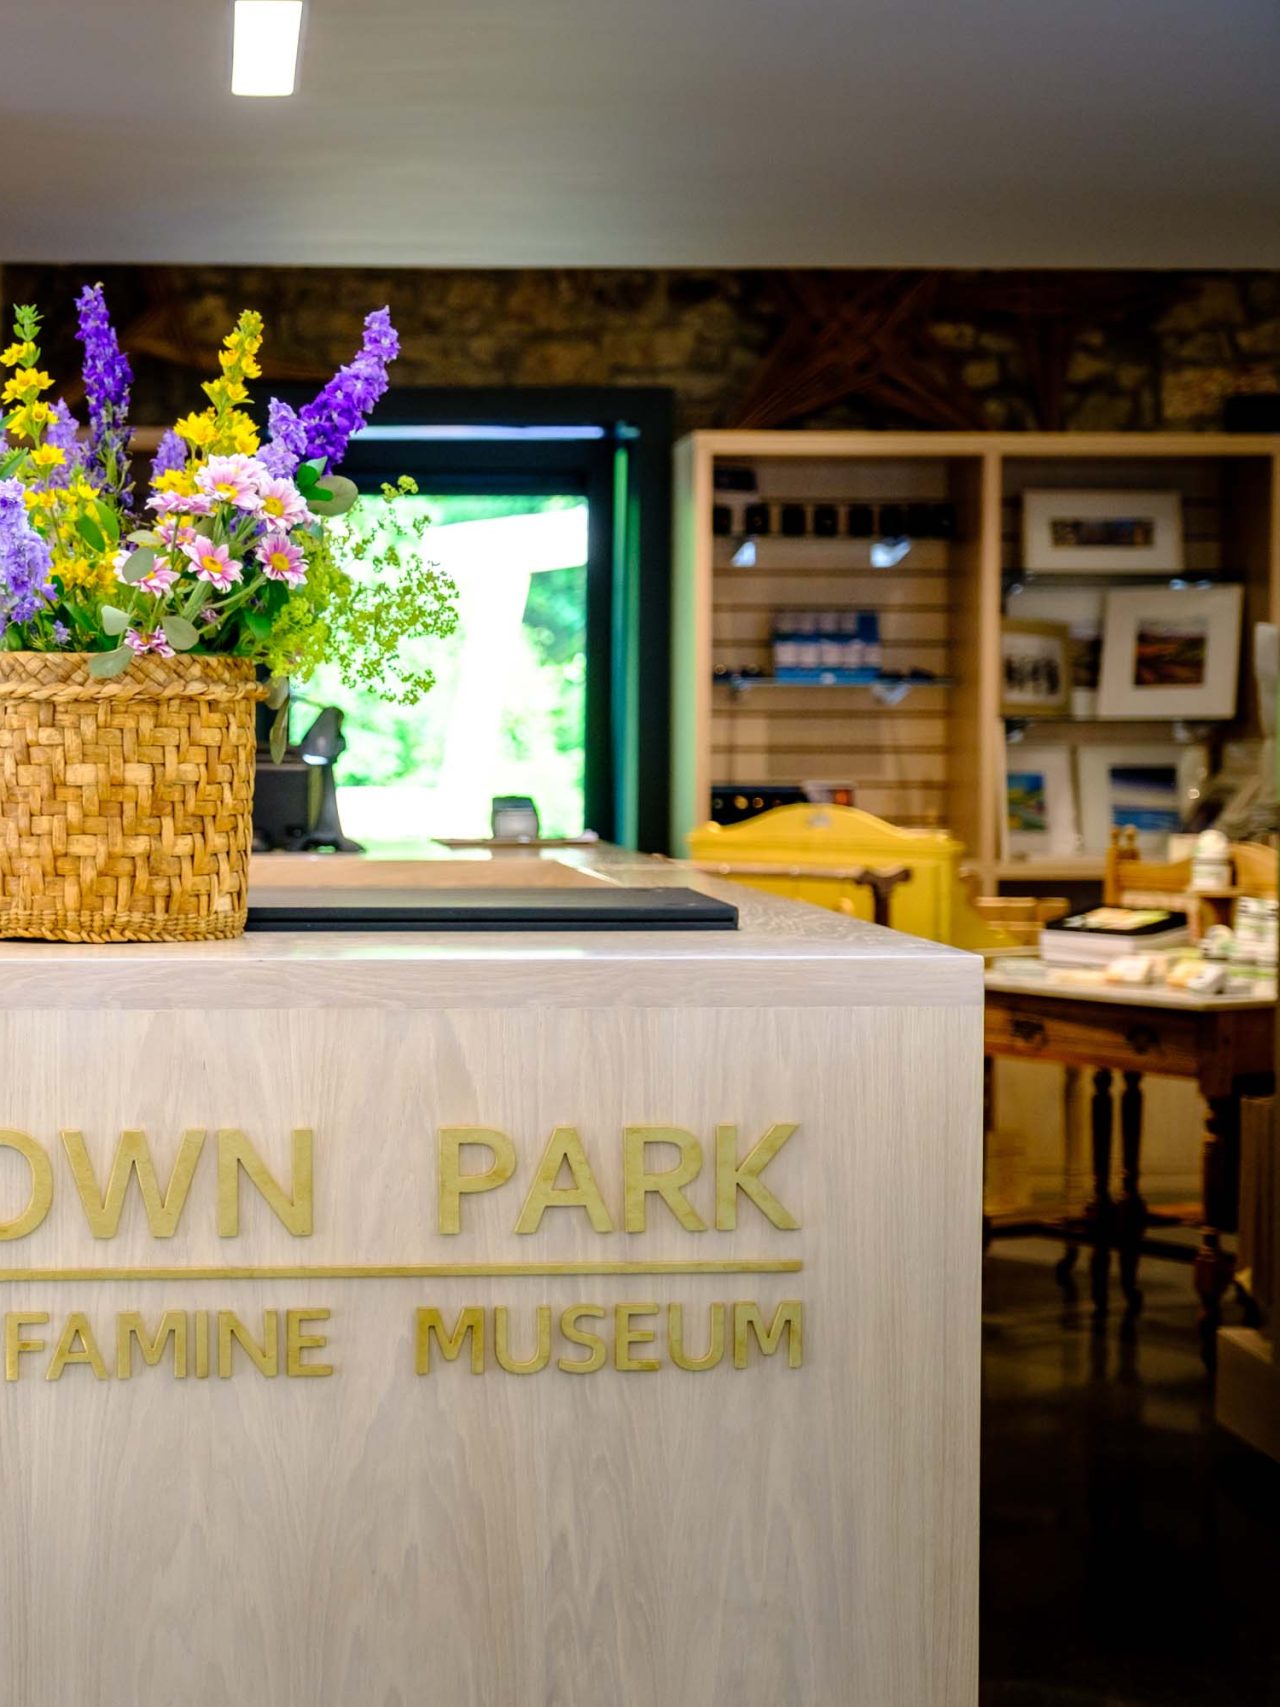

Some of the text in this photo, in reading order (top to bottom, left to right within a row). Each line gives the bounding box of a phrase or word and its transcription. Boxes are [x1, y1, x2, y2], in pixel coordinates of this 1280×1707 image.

[437, 1123, 802, 1235] PARK
[5, 1307, 334, 1381] FAMINE
[415, 1300, 804, 1376] MUSEUM
